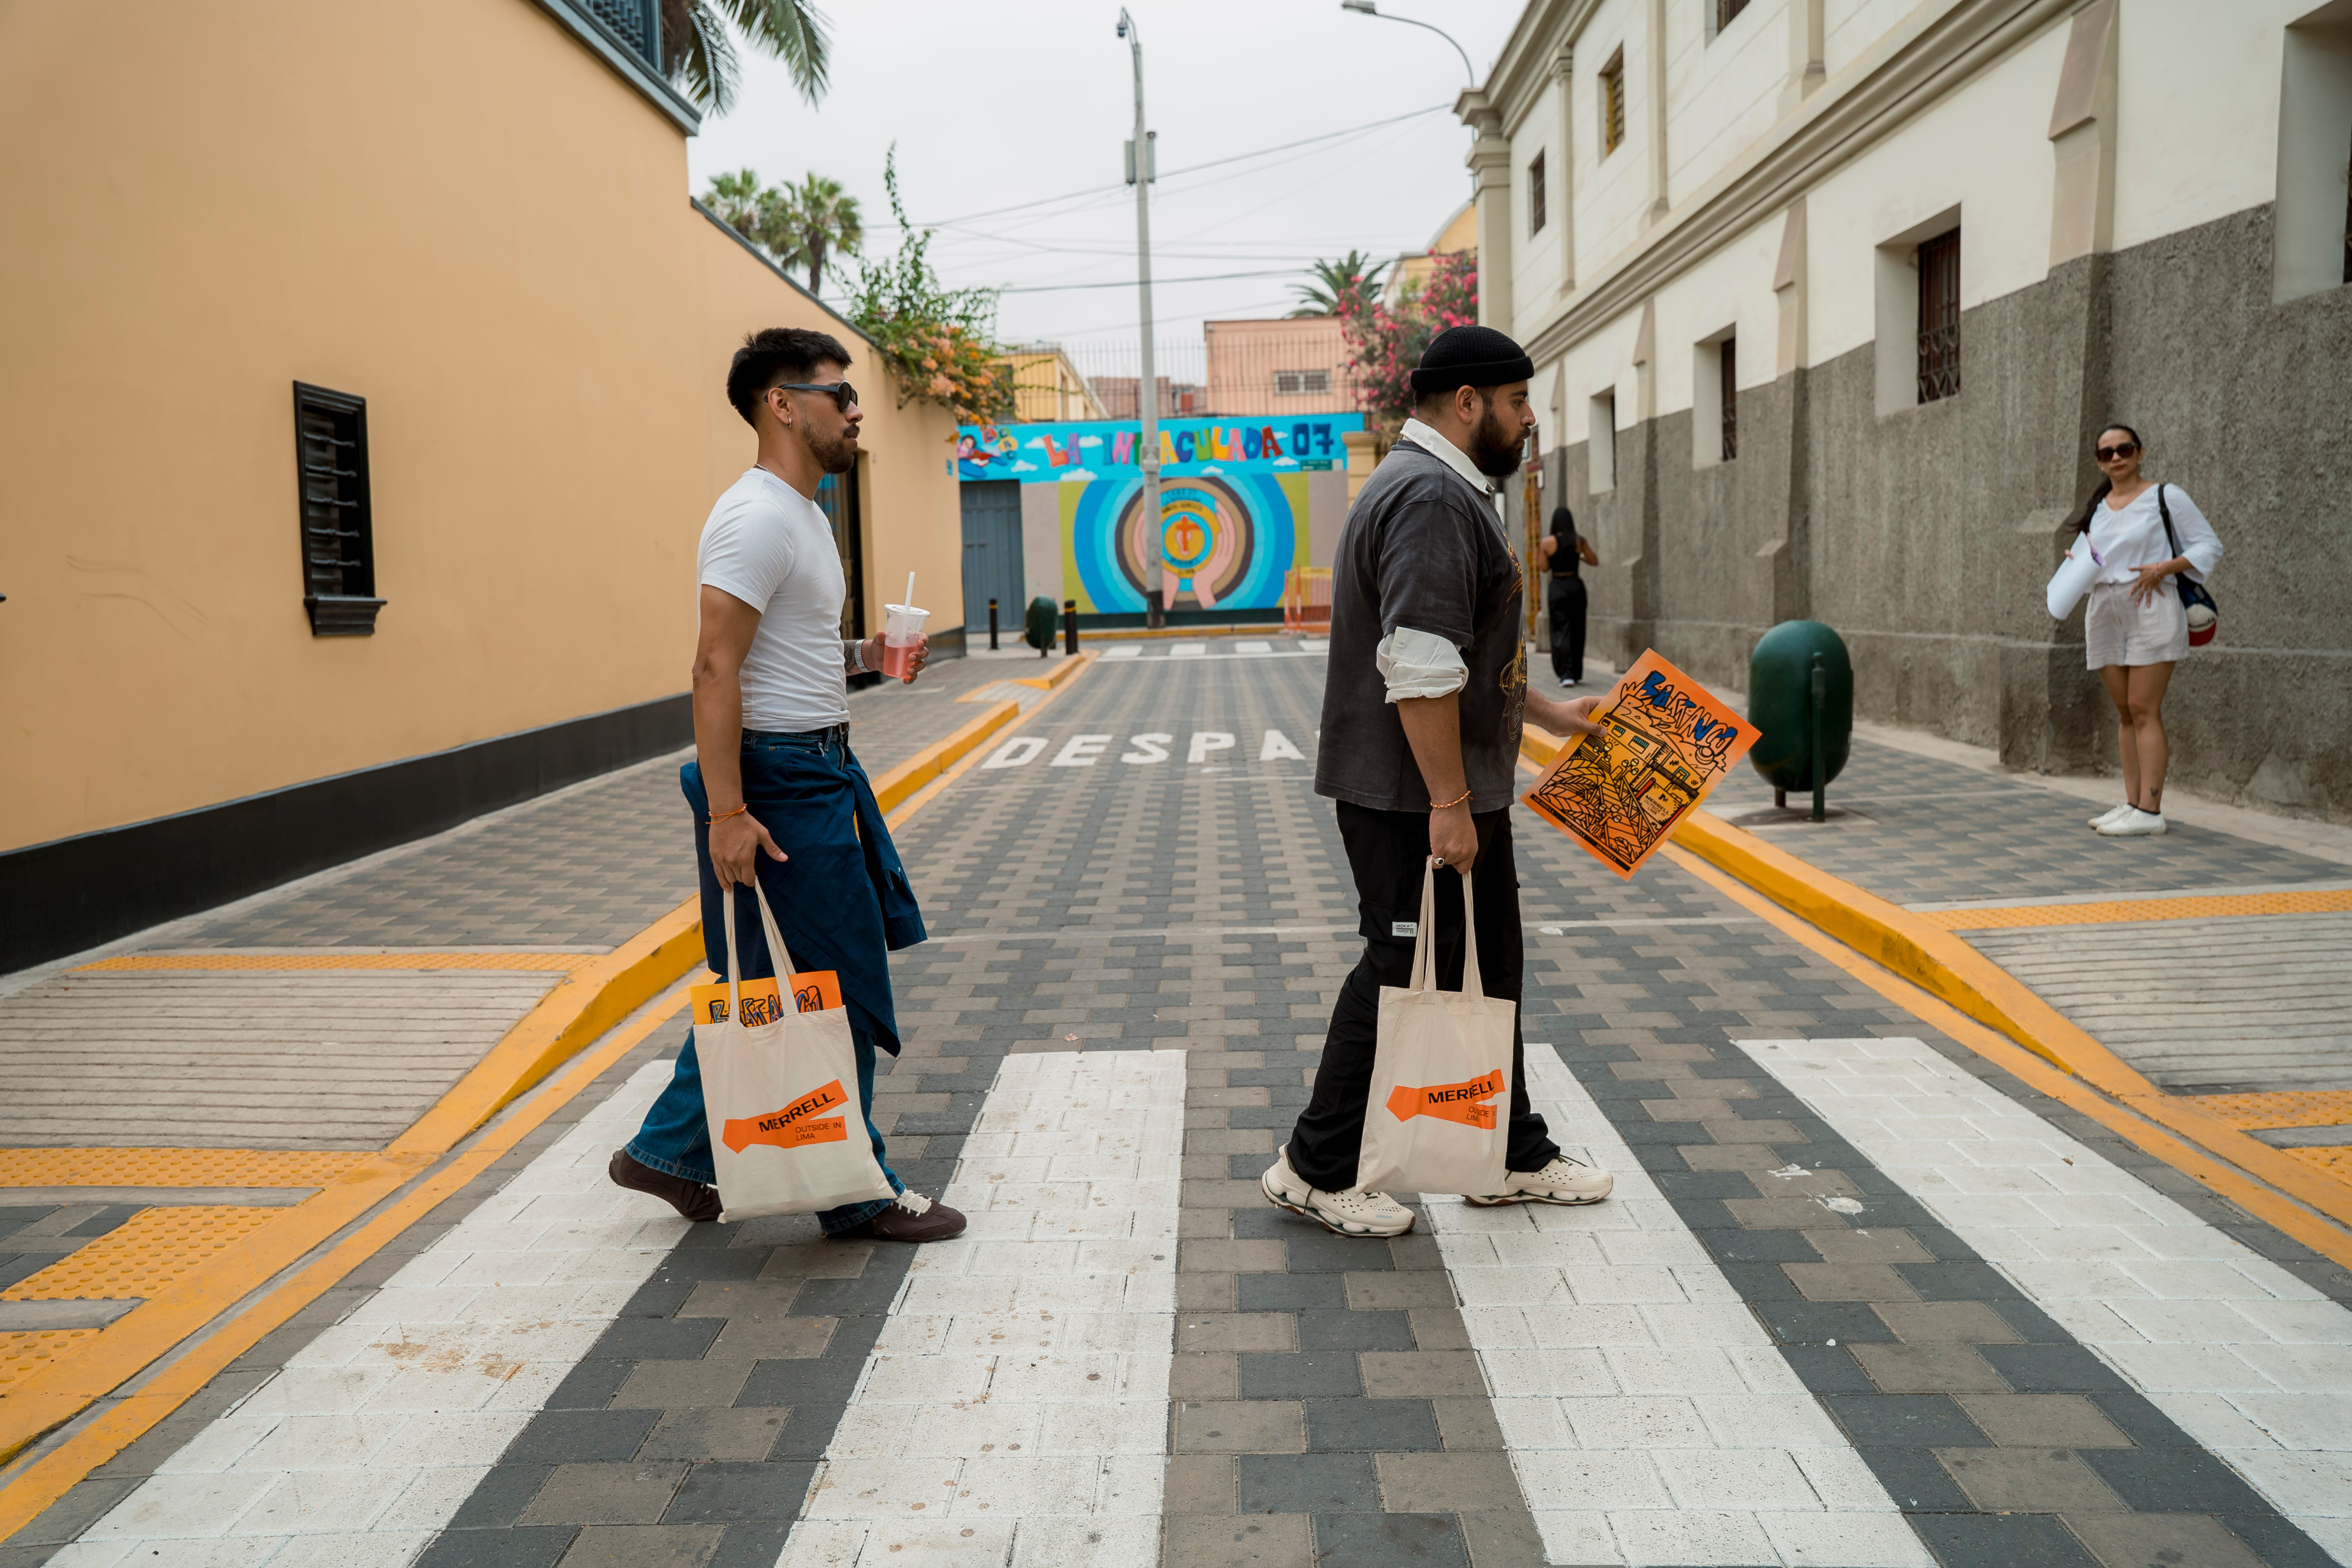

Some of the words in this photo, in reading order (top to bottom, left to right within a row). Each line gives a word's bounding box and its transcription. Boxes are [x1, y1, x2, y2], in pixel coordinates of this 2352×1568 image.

[1042, 433, 1082, 468] LA
[1102, 425, 1283, 466] INACULADA
[1293, 423, 1334, 456] 07
[981, 729, 1321, 769] DESPA
[1645, 795, 1669, 815] MERRELL
[759, 1093, 835, 1132] MERRELL
[795, 1123, 829, 1133] OUTSIDE
[796, 1133, 815, 1141] LIMA
